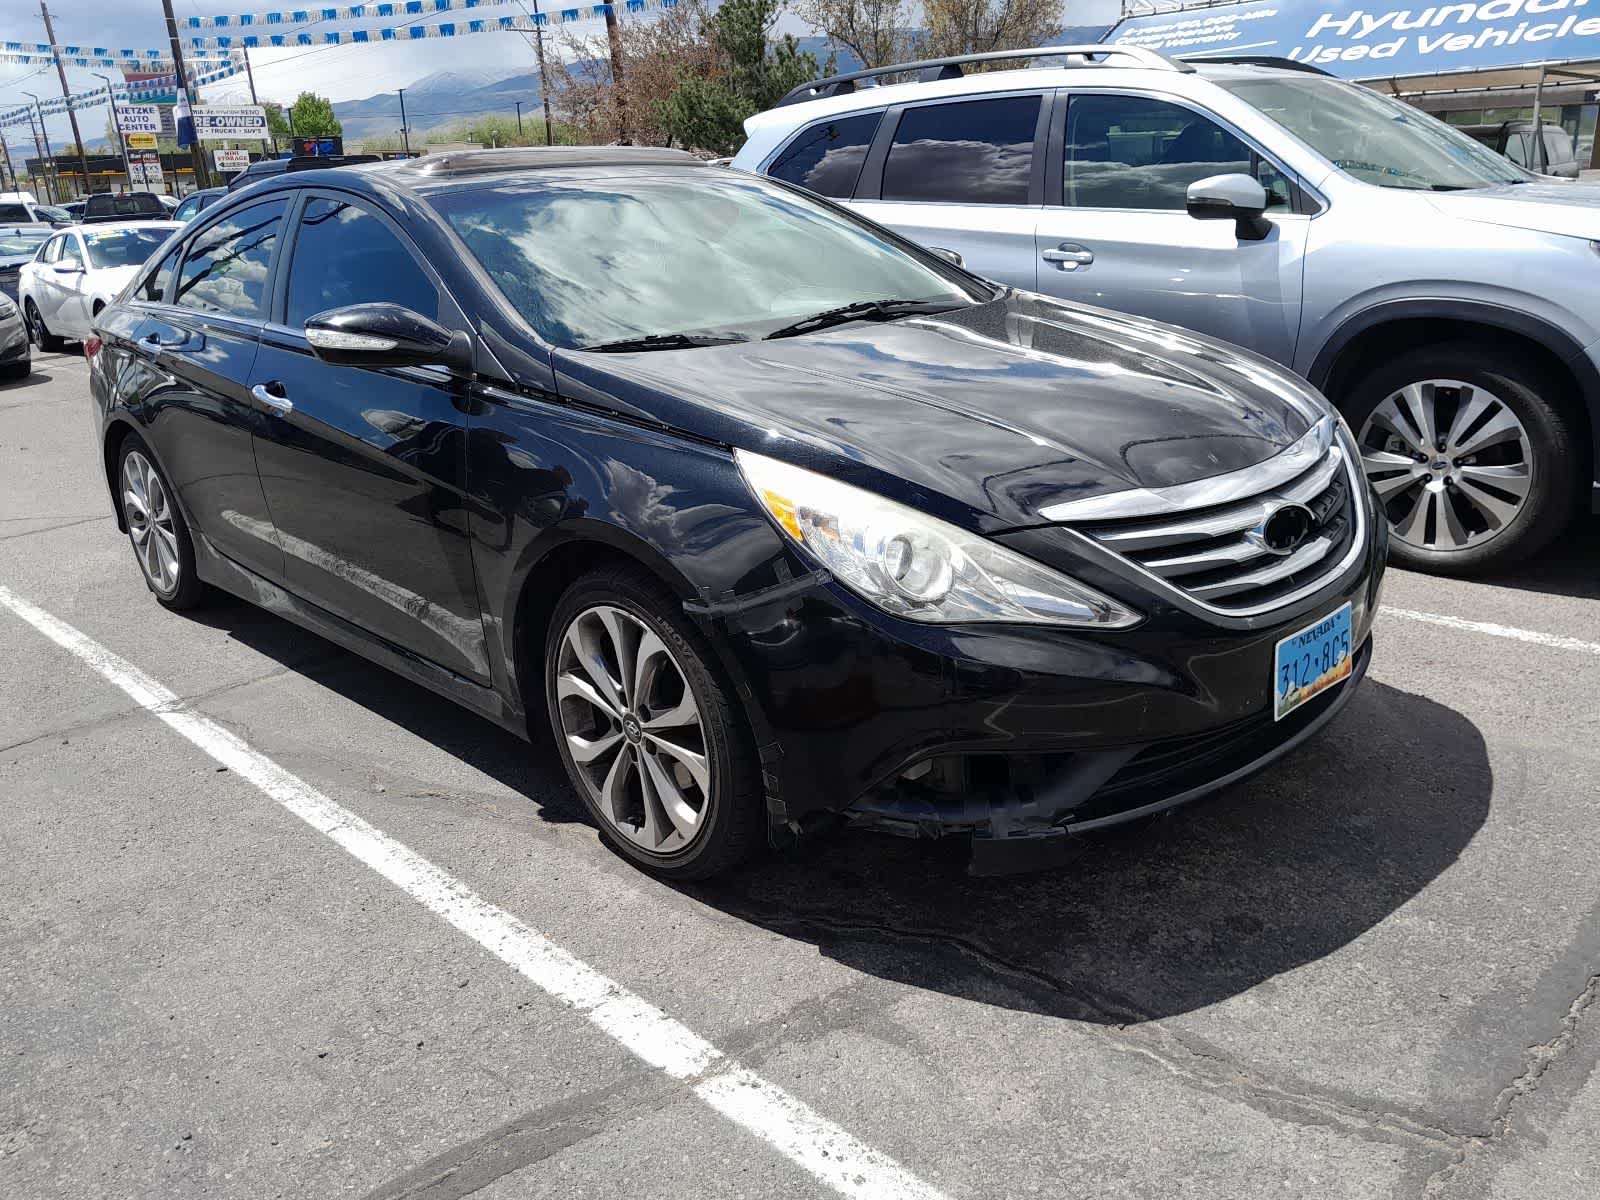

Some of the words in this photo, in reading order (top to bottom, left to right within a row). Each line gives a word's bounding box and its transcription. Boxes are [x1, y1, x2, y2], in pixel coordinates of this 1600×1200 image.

[1304, 0, 1591, 39] Hyunda
[1165, 31, 1242, 48] Warranty
[1286, 36, 1407, 64] Used
[115, 106, 156, 115] KIETZKE
[123, 115, 149, 123] AUTO
[194, 116, 263, 127] RE-OWNED
[119, 123, 156, 131] CENTER
[1298, 619, 1335, 648] NEVADA
